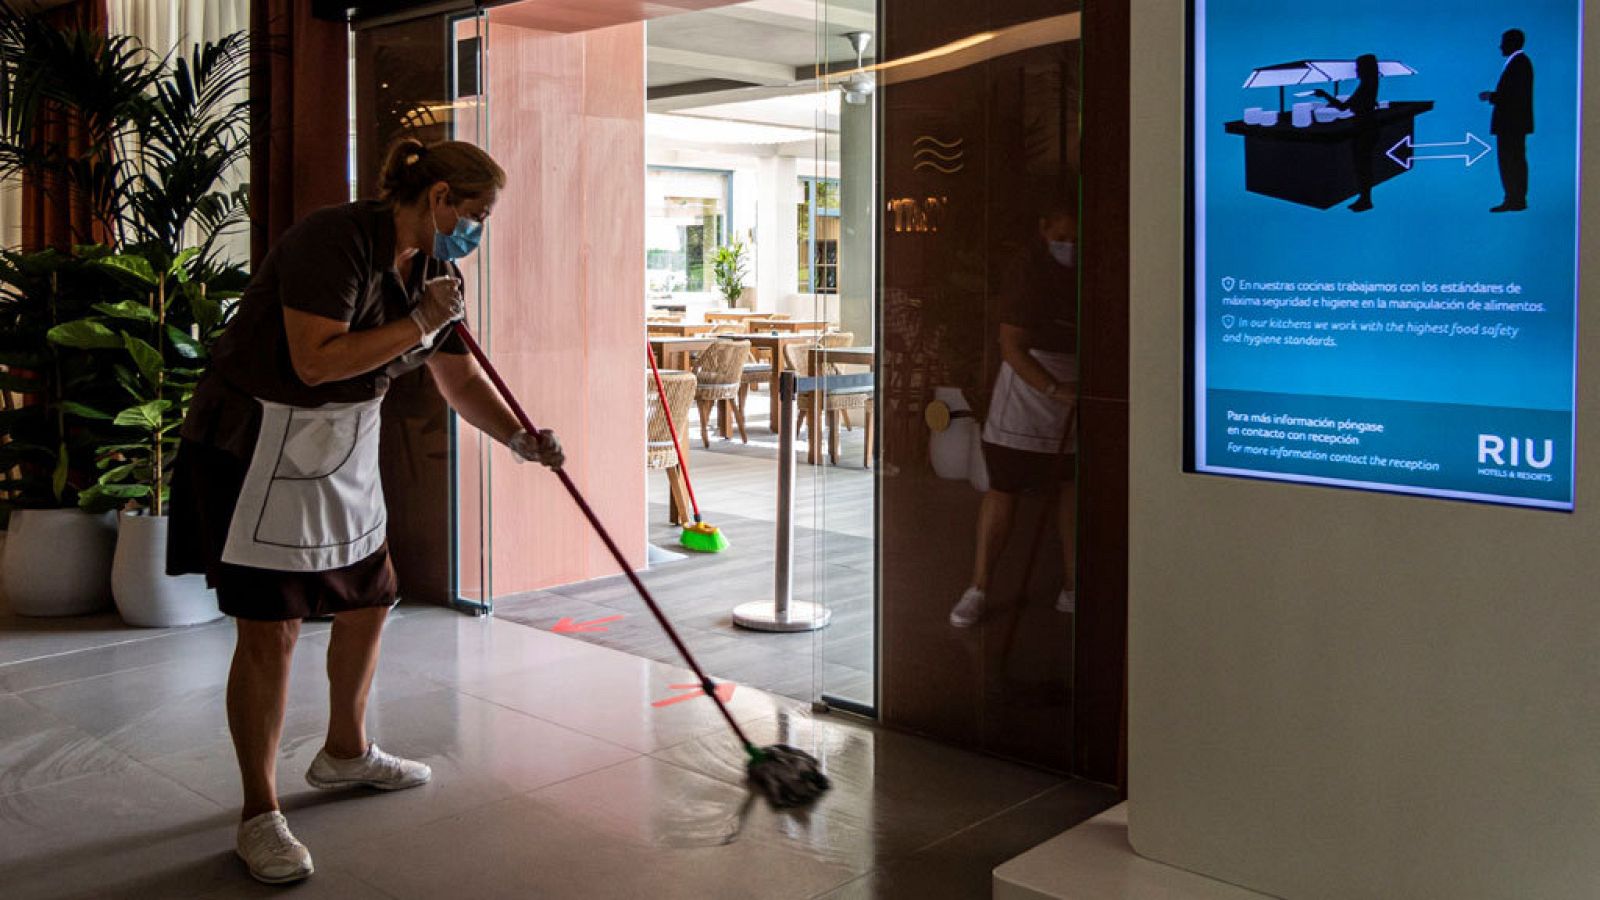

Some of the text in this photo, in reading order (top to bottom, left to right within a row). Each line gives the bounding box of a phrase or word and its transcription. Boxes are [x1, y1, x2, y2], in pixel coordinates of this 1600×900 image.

[1239, 280, 1521, 294] En nuestras cocinas trabajamos con los estándares de
[1222, 295, 1546, 312] máxima seguridad e higiene en la manipulación de alimentos.
[1238, 317, 1519, 339] In our kitchens we work with the highest food safety
[1222, 333, 1337, 346] and hygiene standards.
[1227, 411, 1384, 433] Para más información póngase
[1227, 426, 1359, 445] en contacto con recepción
[1227, 442, 1440, 471] For more information contact the reception
[1478, 434, 1553, 469] RIU
